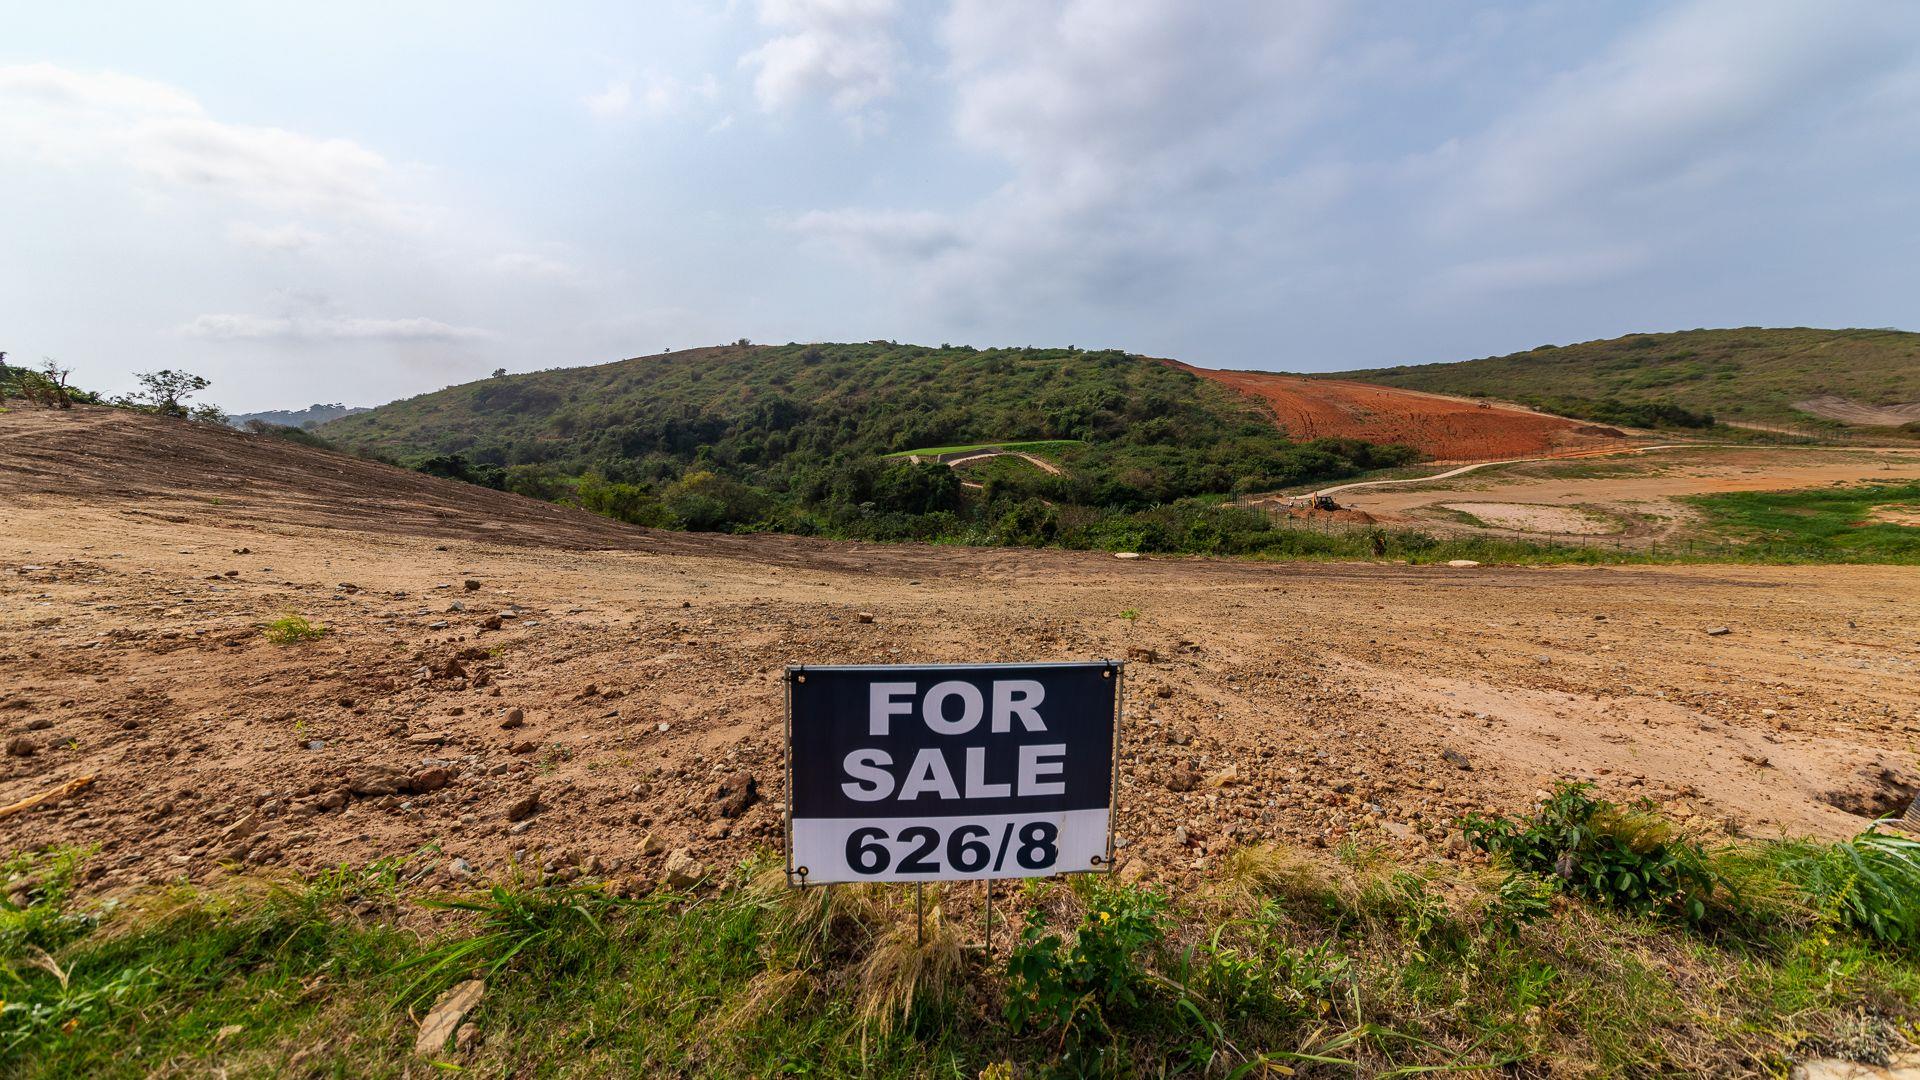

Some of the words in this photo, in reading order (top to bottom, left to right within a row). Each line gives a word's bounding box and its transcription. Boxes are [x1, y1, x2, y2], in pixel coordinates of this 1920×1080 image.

[869, 680, 1048, 736] FOR
[841, 743, 1067, 802] SALE
[845, 821, 1059, 875] 626/8
